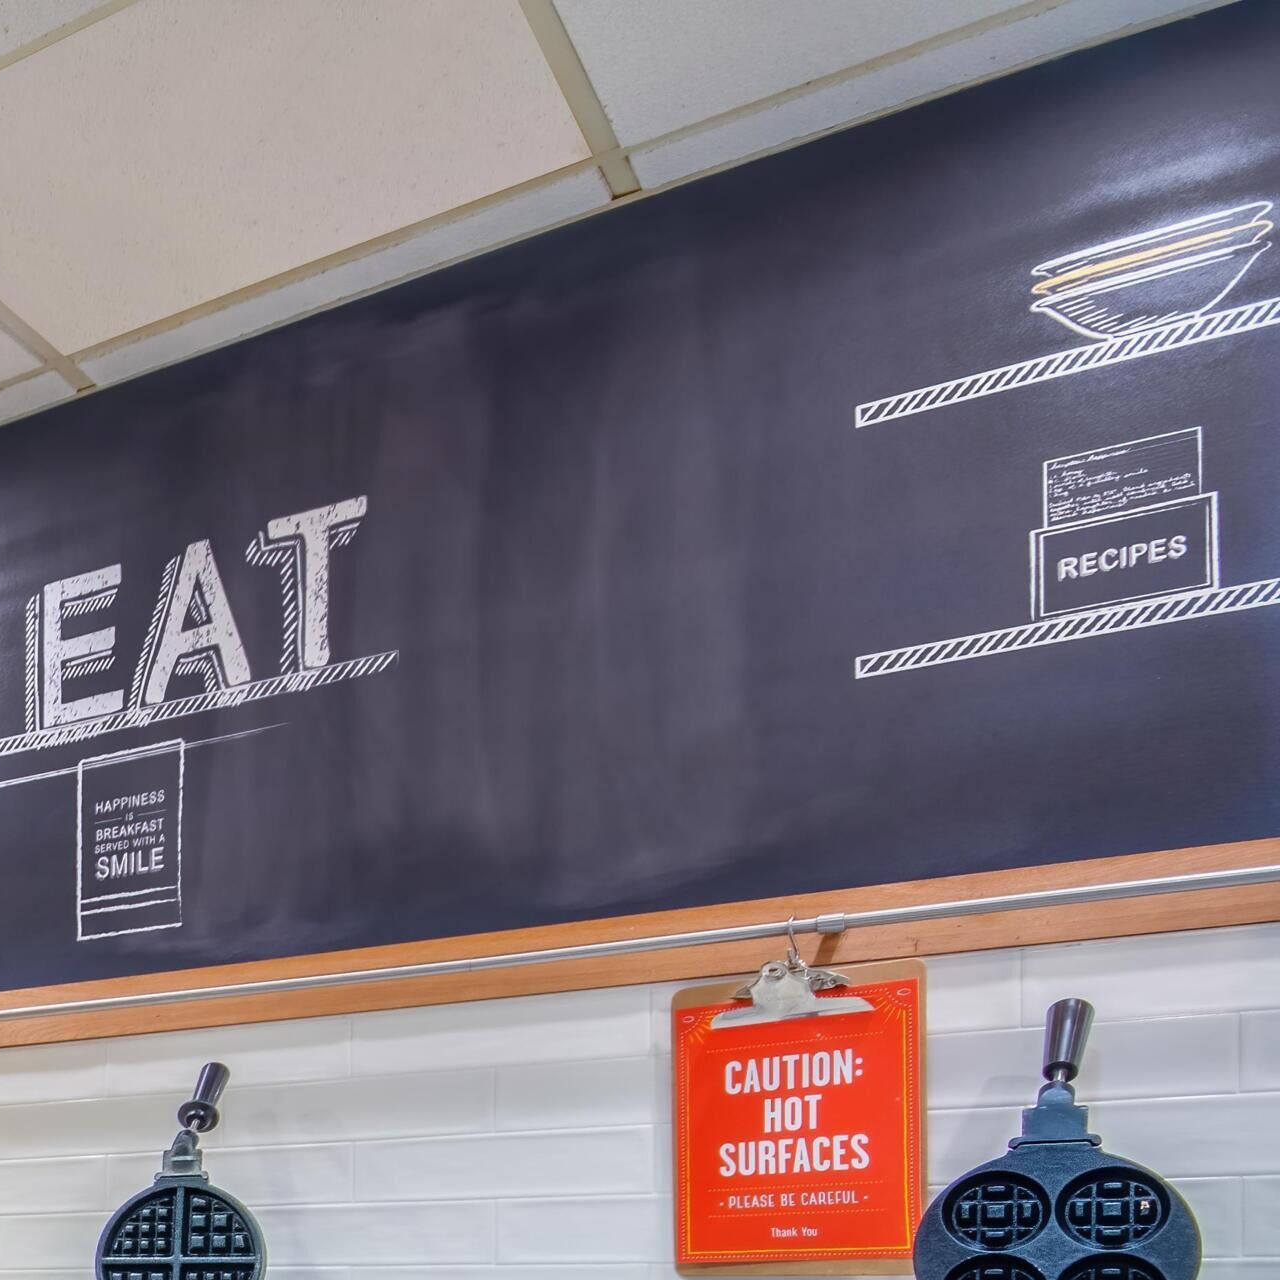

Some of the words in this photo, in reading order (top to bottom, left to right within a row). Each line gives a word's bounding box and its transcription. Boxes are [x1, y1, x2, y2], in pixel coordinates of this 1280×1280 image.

[1057, 535, 1187, 582] RECIPES
[26, 495, 367, 732] EAT
[95, 789, 165, 815] HAPPINESS
[125, 812, 134, 821] IS
[94, 840, 129, 854] SERVED
[133, 835, 155, 847] WITH
[159, 834, 165, 843] A
[96, 817, 164, 842] BREAKFAST
[95, 846, 165, 881] SMILE
[724, 1048, 863, 1095] CAUTION:
[764, 1094, 822, 1133] HOT
[719, 1134, 870, 1177] SURFACES
[728, 1194, 774, 1209] PLEASE
[781, 1193, 795, 1207] BE
[801, 1191, 859, 1206] CAREFUL
[771, 1227, 798, 1238] Thank
[802, 1227, 817, 1237] You
